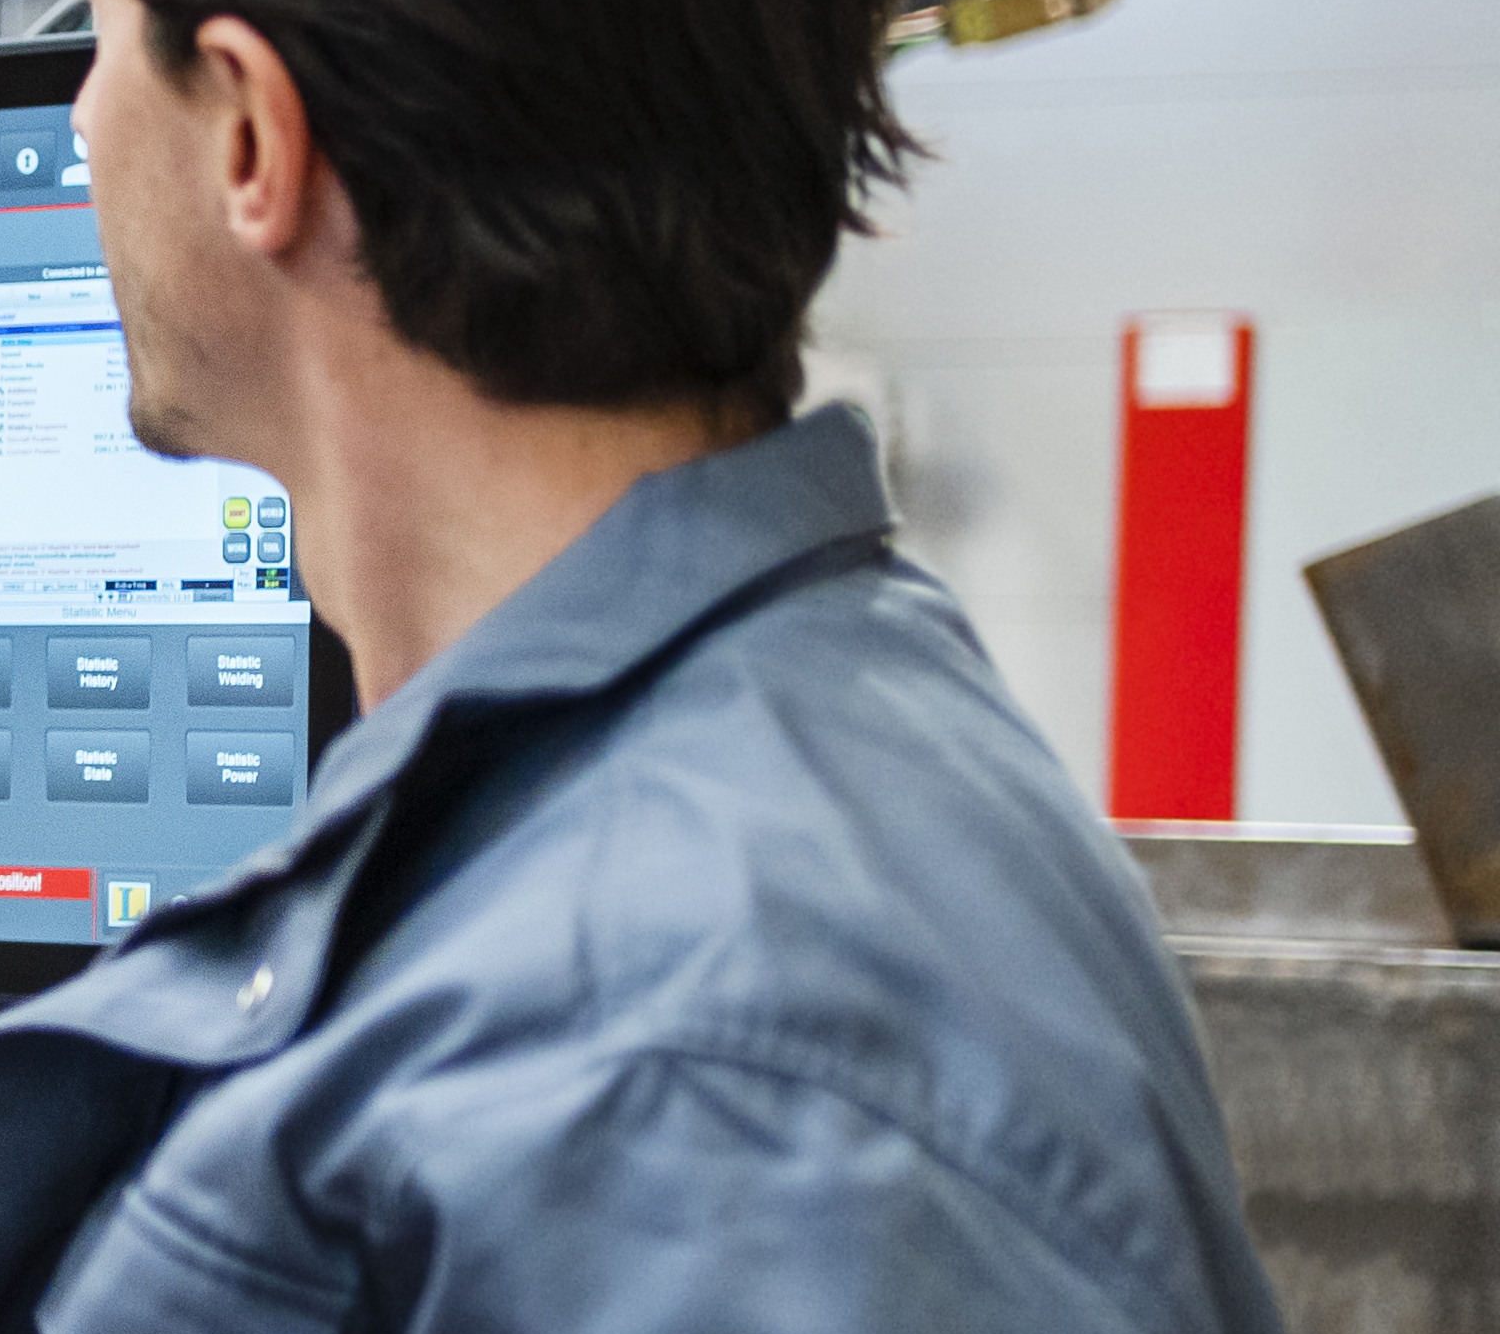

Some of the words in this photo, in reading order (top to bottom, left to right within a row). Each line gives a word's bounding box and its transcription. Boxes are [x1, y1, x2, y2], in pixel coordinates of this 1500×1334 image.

[107, 605, 137, 618] Menu
[79, 673, 119, 690] History
[218, 671, 264, 689] Welding
[83, 766, 113, 782] State
[221, 768, 259, 784] Power
